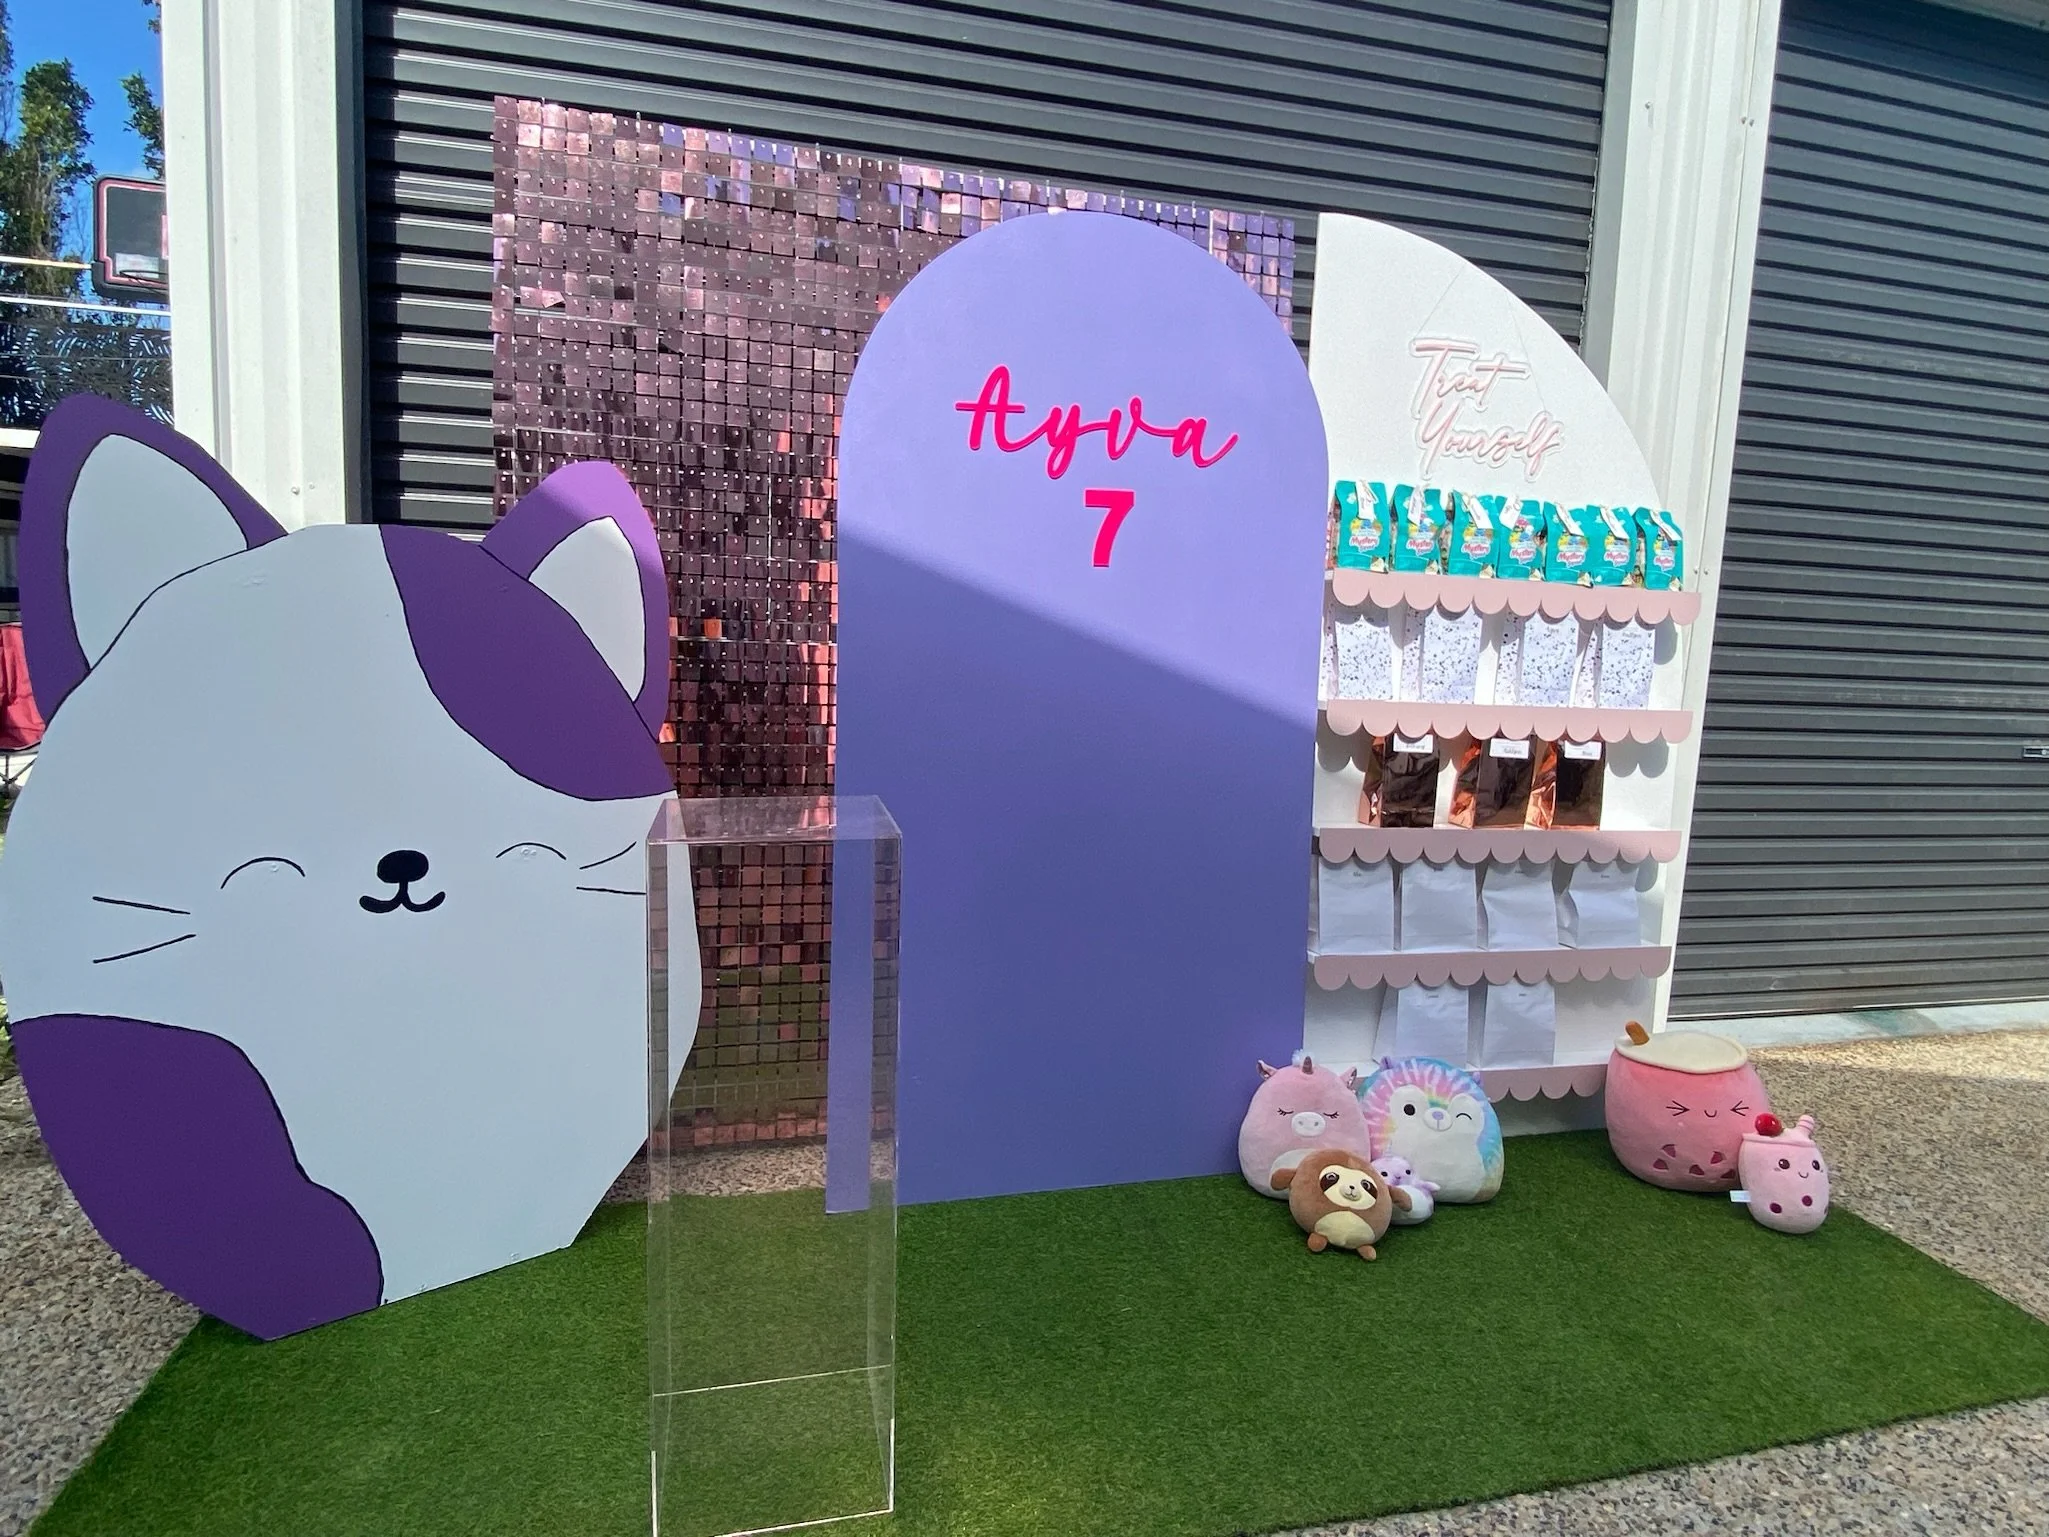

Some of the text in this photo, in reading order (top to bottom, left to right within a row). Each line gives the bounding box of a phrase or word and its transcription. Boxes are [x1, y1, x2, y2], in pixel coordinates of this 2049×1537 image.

[1413, 340, 1529, 416] Treat
[955, 365, 1238, 479] Ayva
[1420, 401, 1561, 477] Yourself
[1085, 489, 1134, 567] 7
